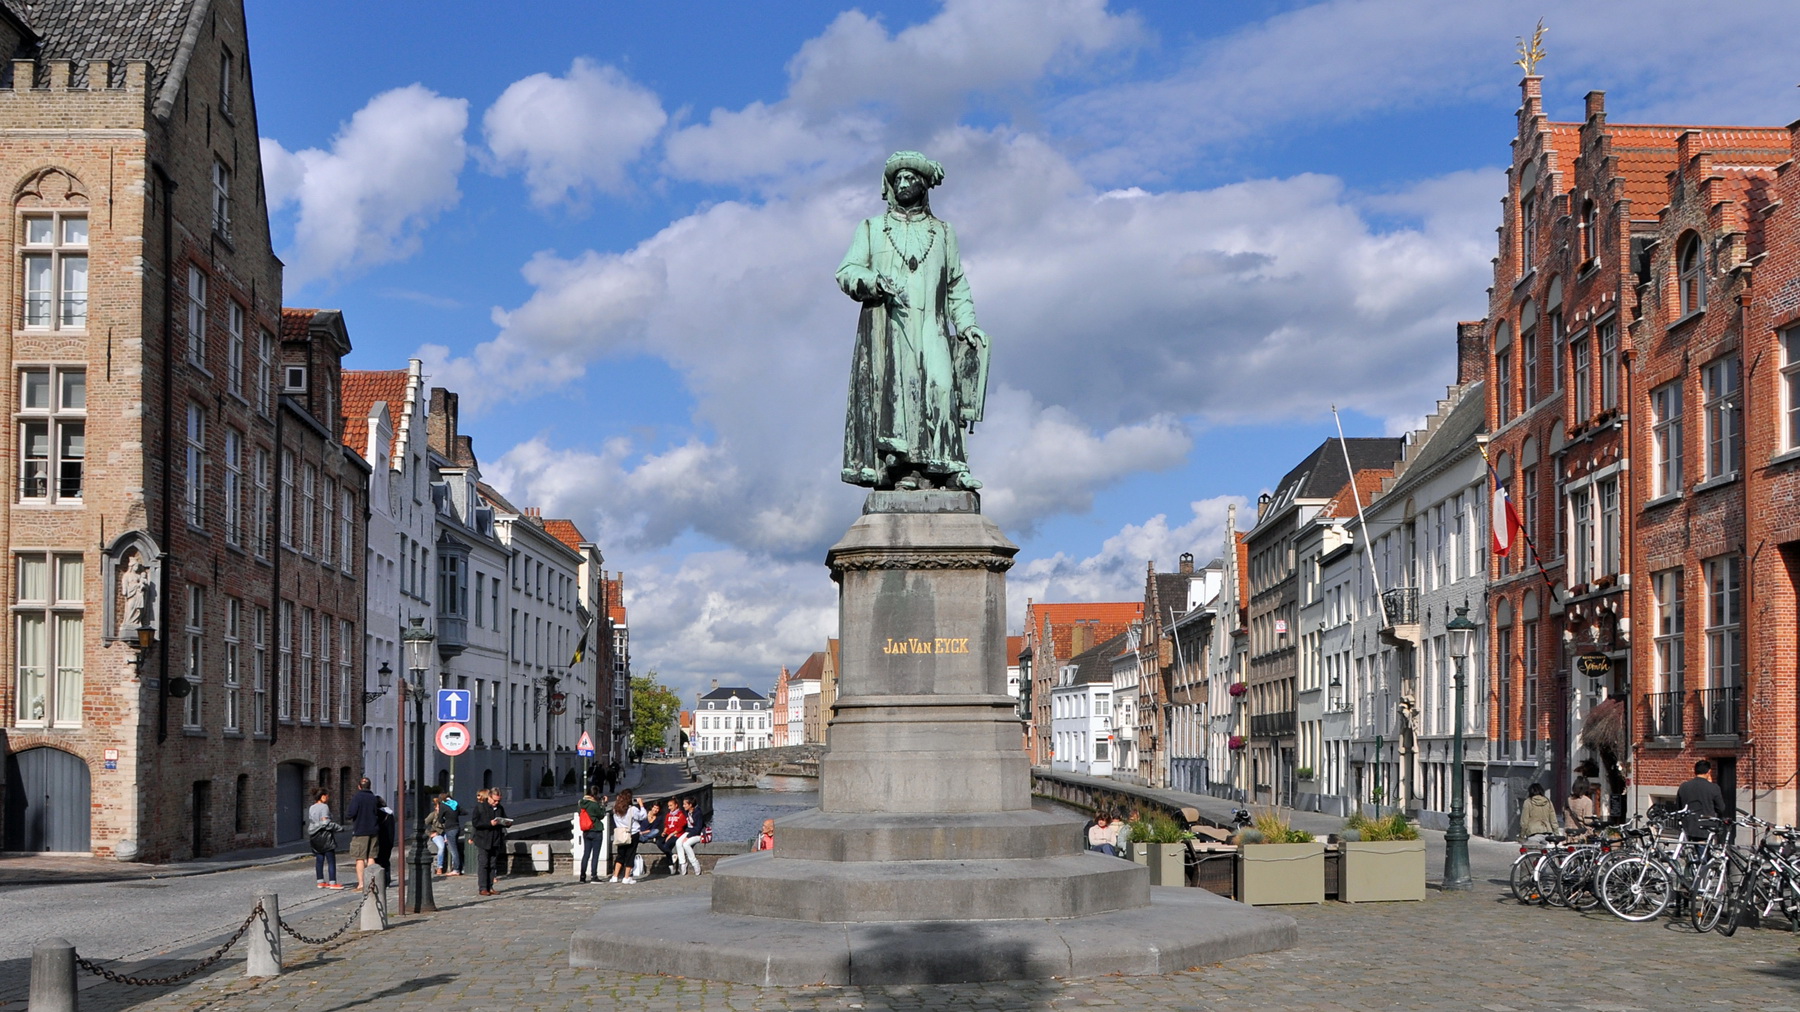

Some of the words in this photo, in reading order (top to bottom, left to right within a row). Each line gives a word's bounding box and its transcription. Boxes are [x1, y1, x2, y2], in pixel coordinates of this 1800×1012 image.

[883, 638, 908, 654] JAN
[908, 638, 932, 654] VAN
[934, 638, 969, 654] EYCK
